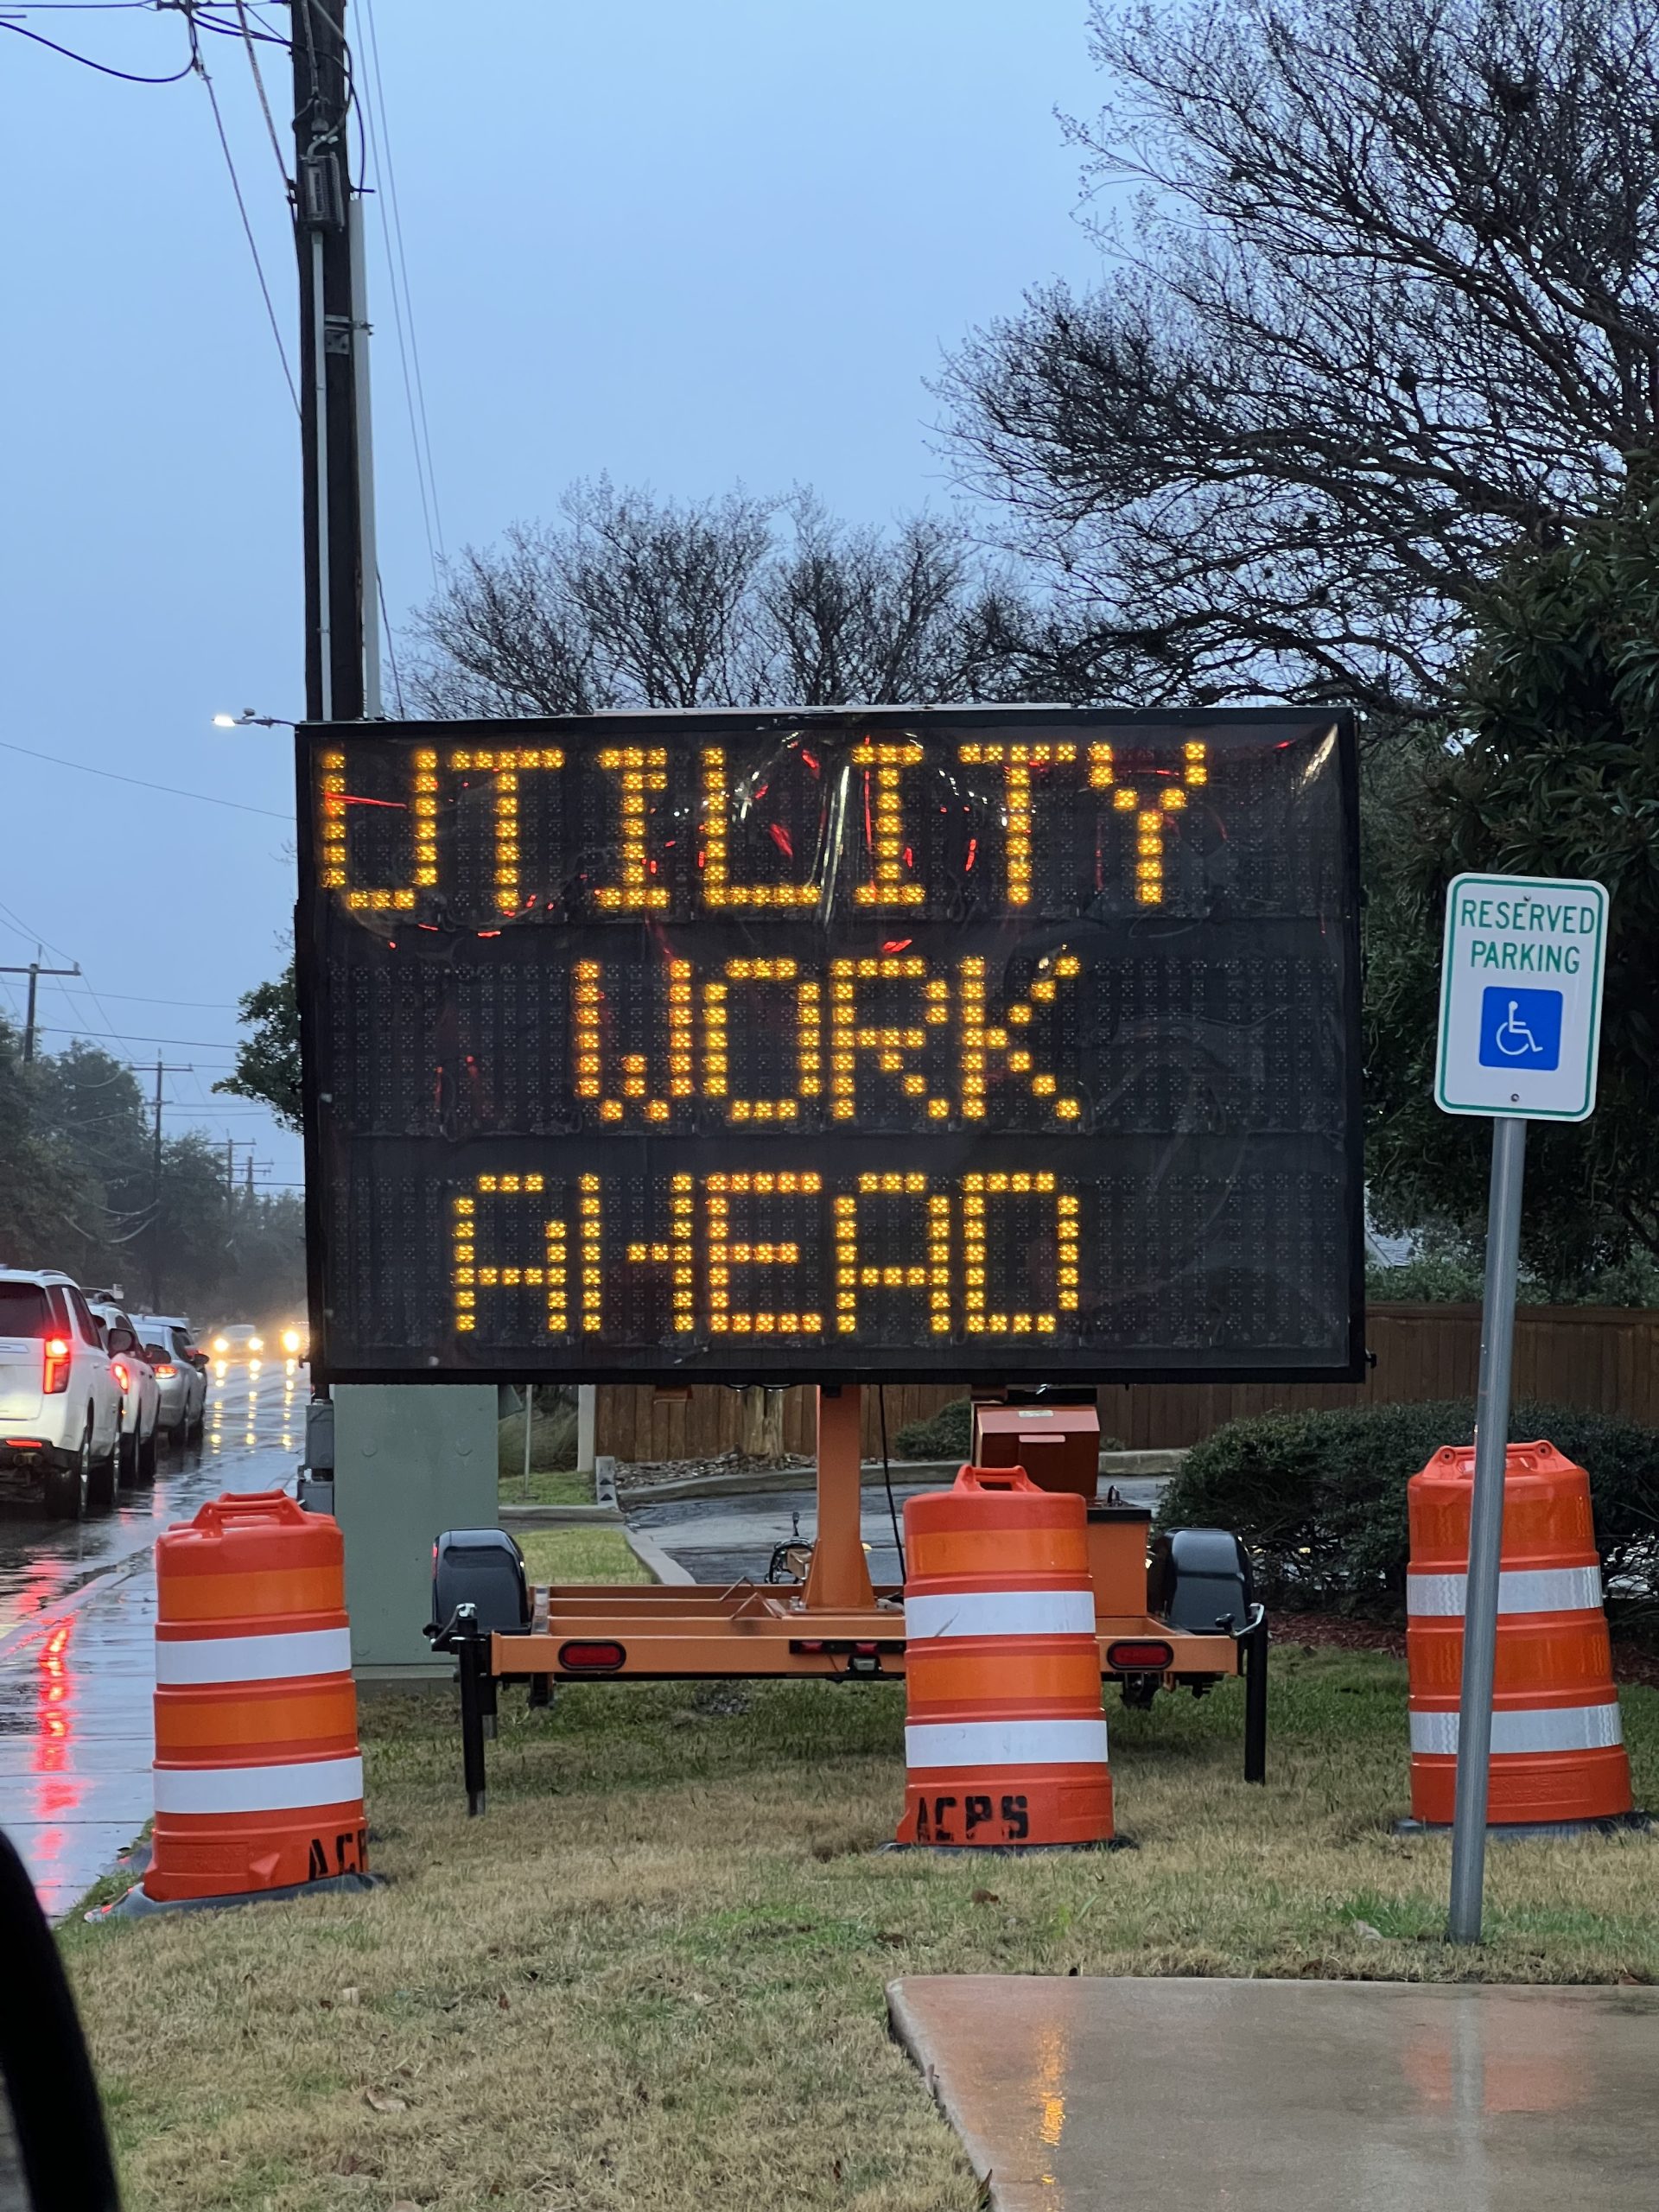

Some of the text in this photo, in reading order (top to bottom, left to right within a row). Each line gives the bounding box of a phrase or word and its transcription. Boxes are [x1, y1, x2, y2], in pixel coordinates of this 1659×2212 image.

[321, 744, 1209, 910] UTILITY
[1461, 899, 1595, 934] RESERVED
[1471, 940, 1580, 974] PARKING
[574, 955, 1081, 1120] WORK
[454, 1173, 1079, 1332] AHEAD
[916, 1795, 1029, 1842] ACPS
